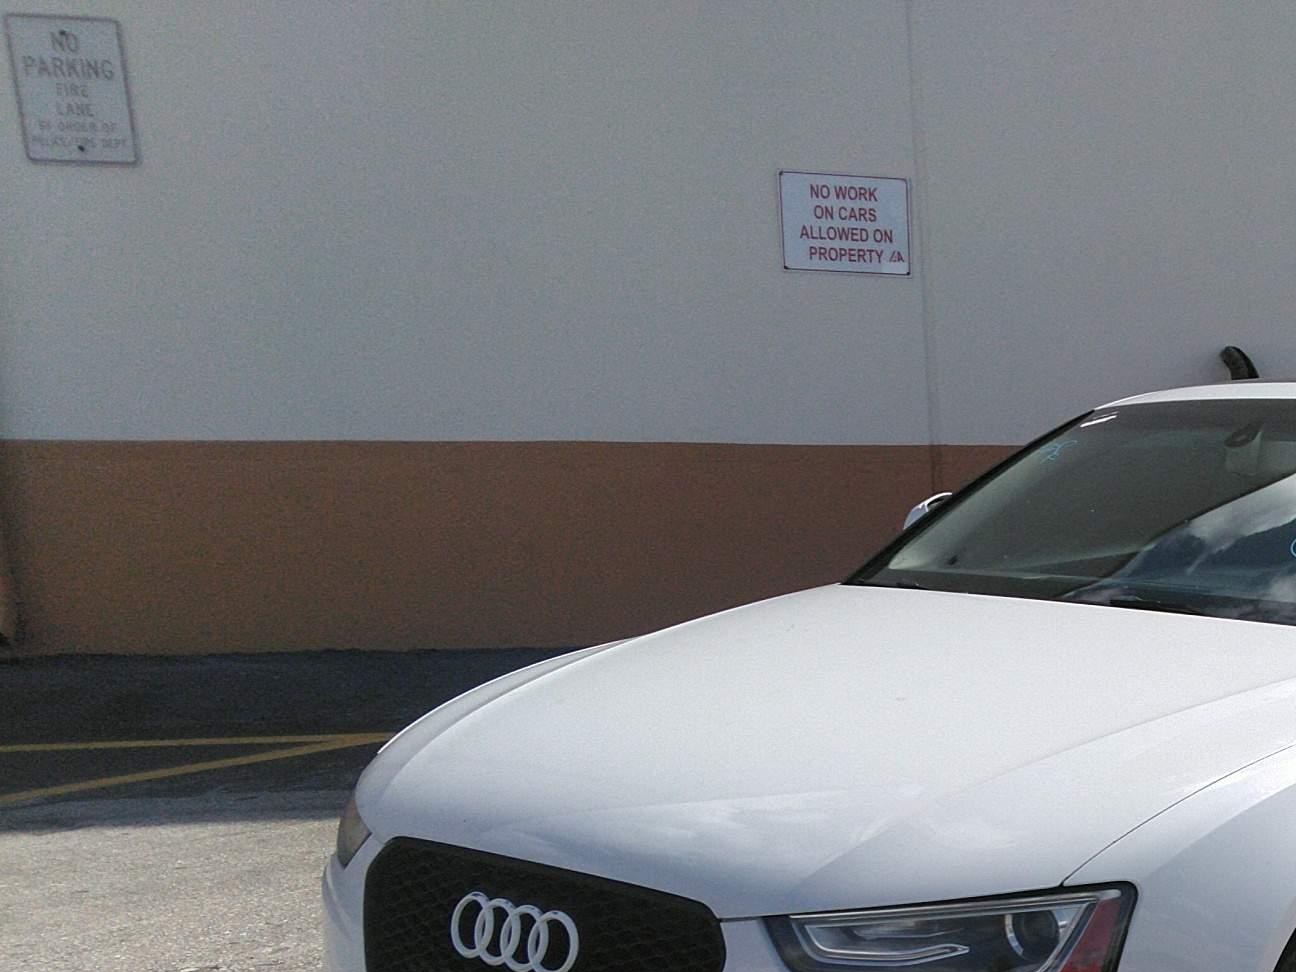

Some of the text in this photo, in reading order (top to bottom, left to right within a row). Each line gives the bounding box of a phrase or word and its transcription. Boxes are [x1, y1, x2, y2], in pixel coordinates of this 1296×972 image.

[49, 30, 80, 53] NO
[22, 55, 115, 81] PARKING
[56, 82, 89, 98] FIRE
[56, 102, 95, 118] LANE
[810, 184, 878, 202] NO WORK
[814, 205, 877, 222] ON CARS
[800, 225, 893, 243] ALLOWED ON
[809, 246, 884, 264] PROPERTY
